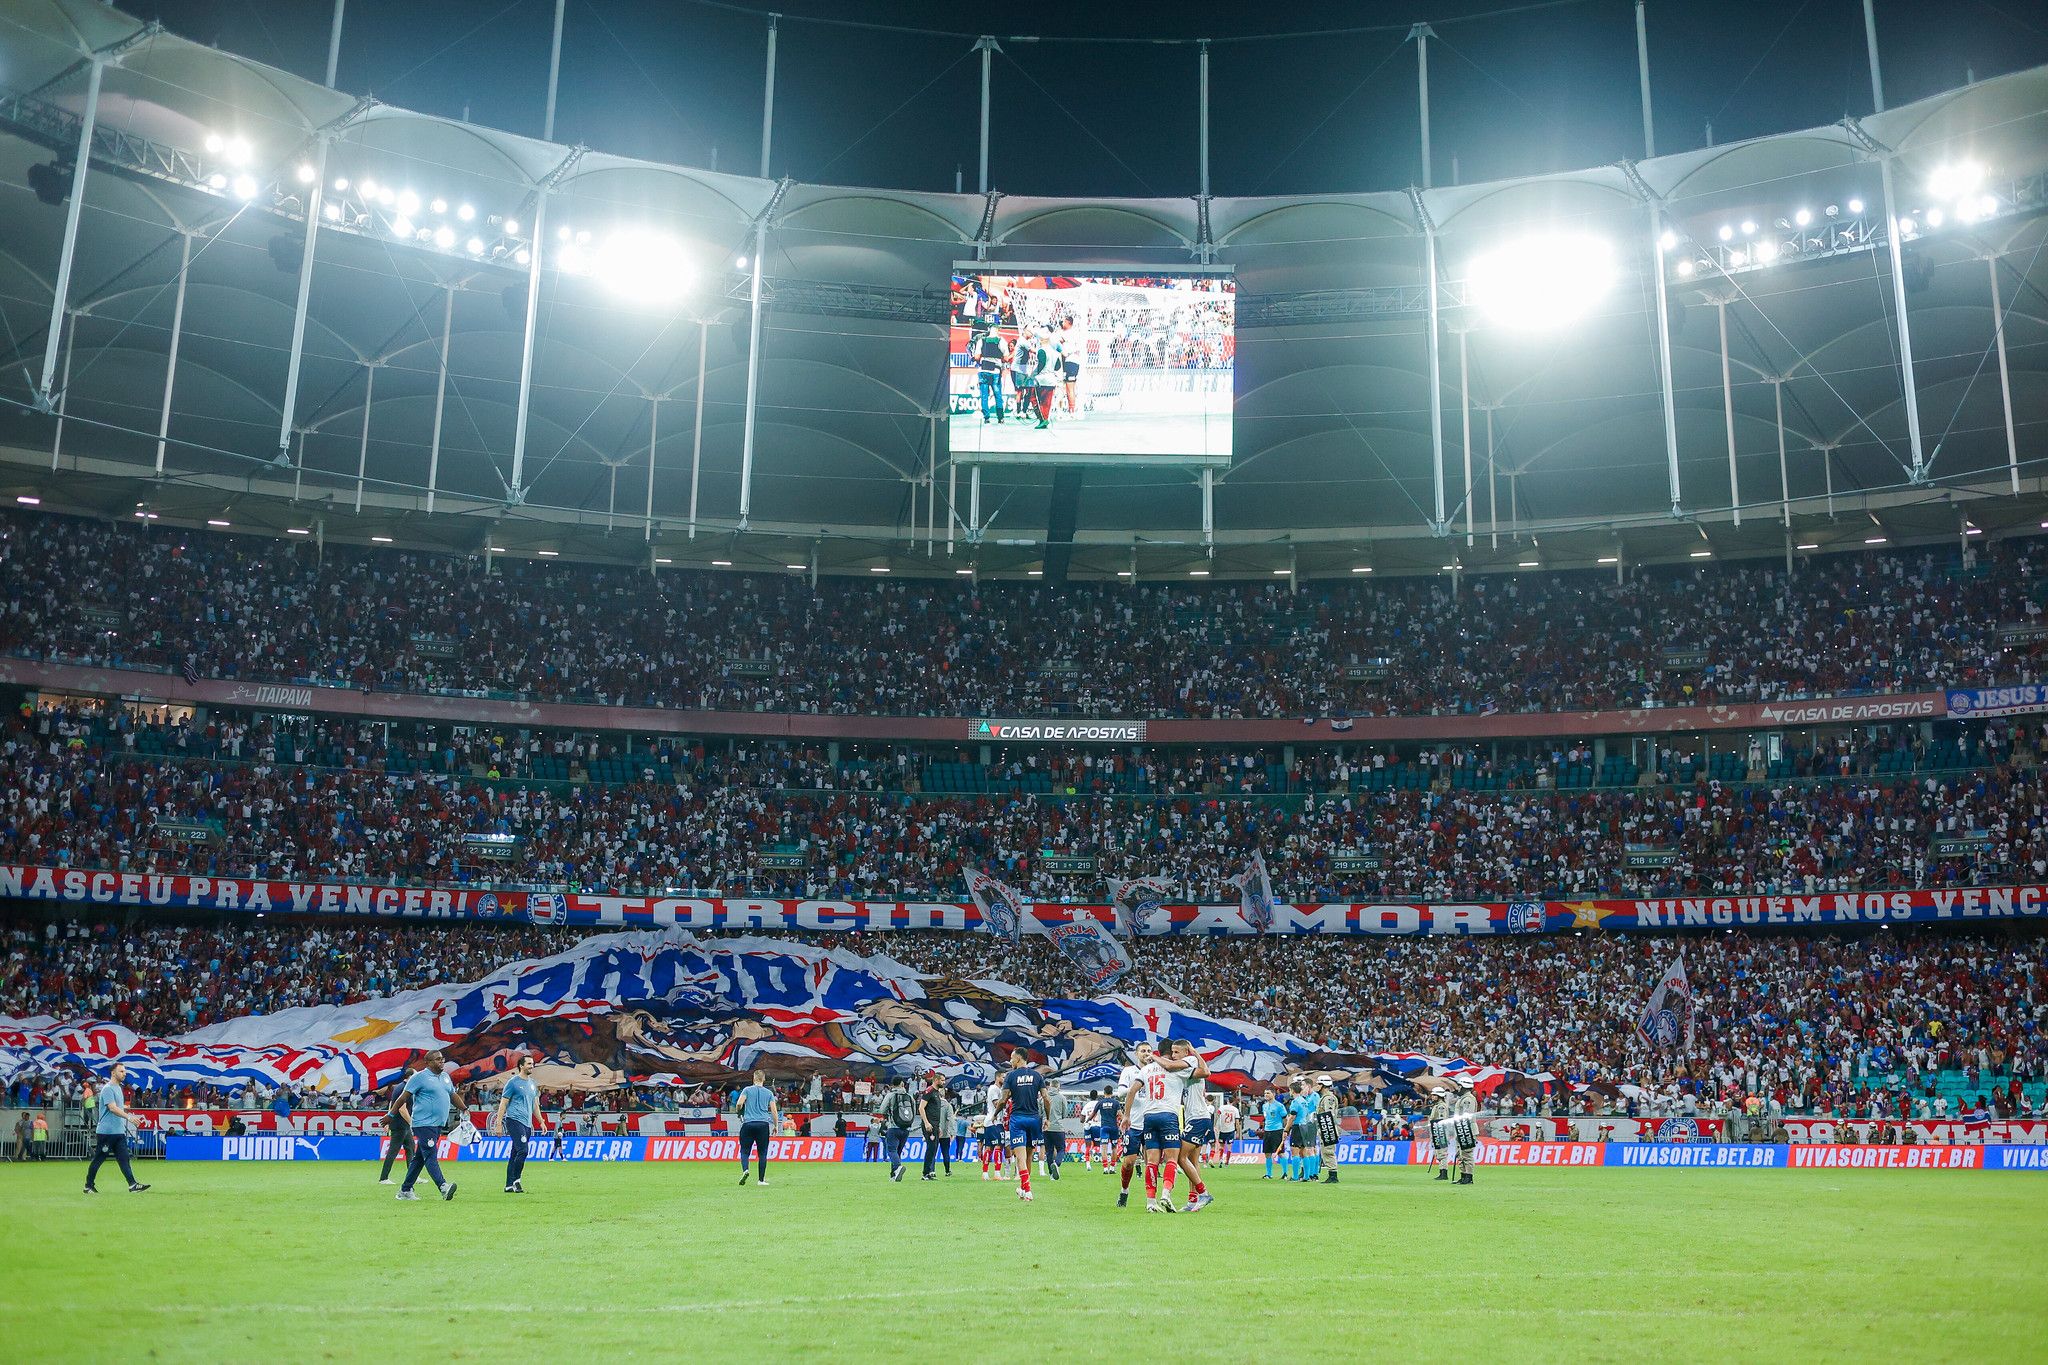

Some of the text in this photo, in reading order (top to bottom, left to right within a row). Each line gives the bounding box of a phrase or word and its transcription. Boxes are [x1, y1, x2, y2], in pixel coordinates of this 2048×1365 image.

[255, 686, 312, 706] ITAIPAVA
[1973, 685, 2037, 708] JESUS
[1784, 701, 1933, 722] CASA DE APOSTAS
[1000, 726, 1137, 739] CASA DE APOSTAS
[191, 831, 206, 839] 223
[497, 848, 511, 856] 222
[1941, 844, 1955, 852] 217
[1662, 856, 1675, 864] 217
[0, 866, 174, 905] NASCEU
[187, 877, 272, 911] PRA
[288, 884, 468, 919] VENCER!
[1636, 887, 2048, 926] NINGUÉM NOS VENC
[1148, 1074, 1166, 1101] 15
[158, 1114, 212, 1136] 59
[222, 1136, 294, 1160] PUMA
[1623, 1146, 1775, 1166] VIVASORTE.BET.BR
[1795, 1147, 1976, 1168] VIVASORTE.BET.BR
